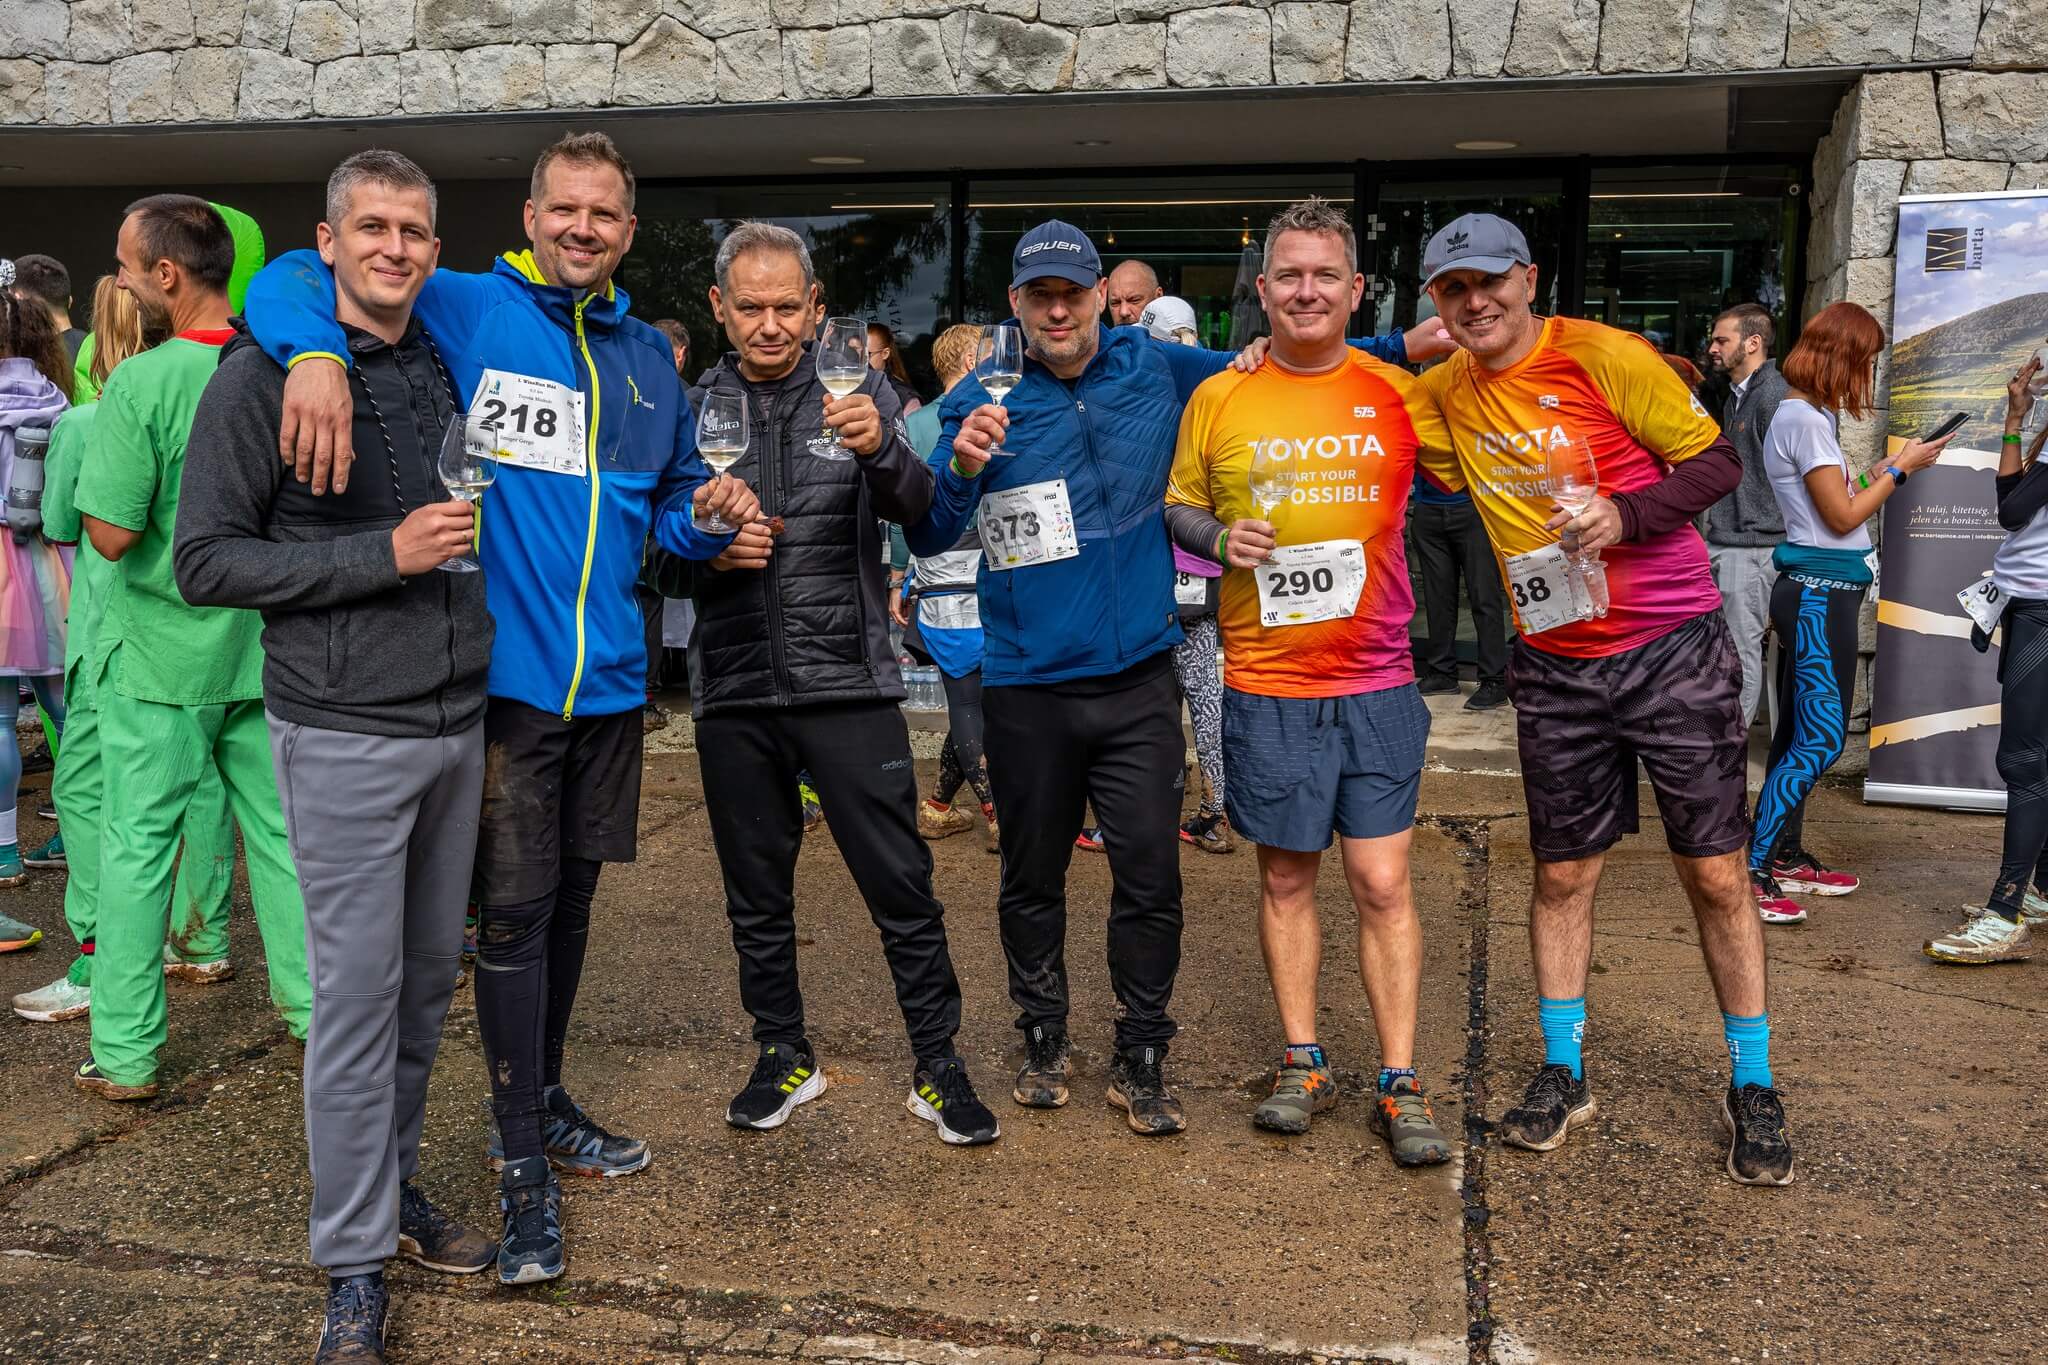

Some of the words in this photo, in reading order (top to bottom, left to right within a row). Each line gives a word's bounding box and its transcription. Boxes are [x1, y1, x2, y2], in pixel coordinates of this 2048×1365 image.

[1447, 243, 1469, 254] adidas
[1967, 226, 1985, 271] barta
[479, 398, 557, 438] 218
[1353, 406, 1377, 418] 575
[1247, 434, 1386, 462] TOYOTA
[1474, 424, 1573, 454] TOYOTA
[1275, 471, 1318, 482] START
[1320, 469, 1357, 481] YOUR
[1491, 466, 1517, 476] START
[1519, 464, 1546, 475] YOUR
[1909, 515, 1931, 526] jelen
[1932, 515, 1941, 524] és
[1926, 505, 1948, 516] talaj,
[986, 511, 1040, 544] 373
[1267, 567, 1334, 599] 290
